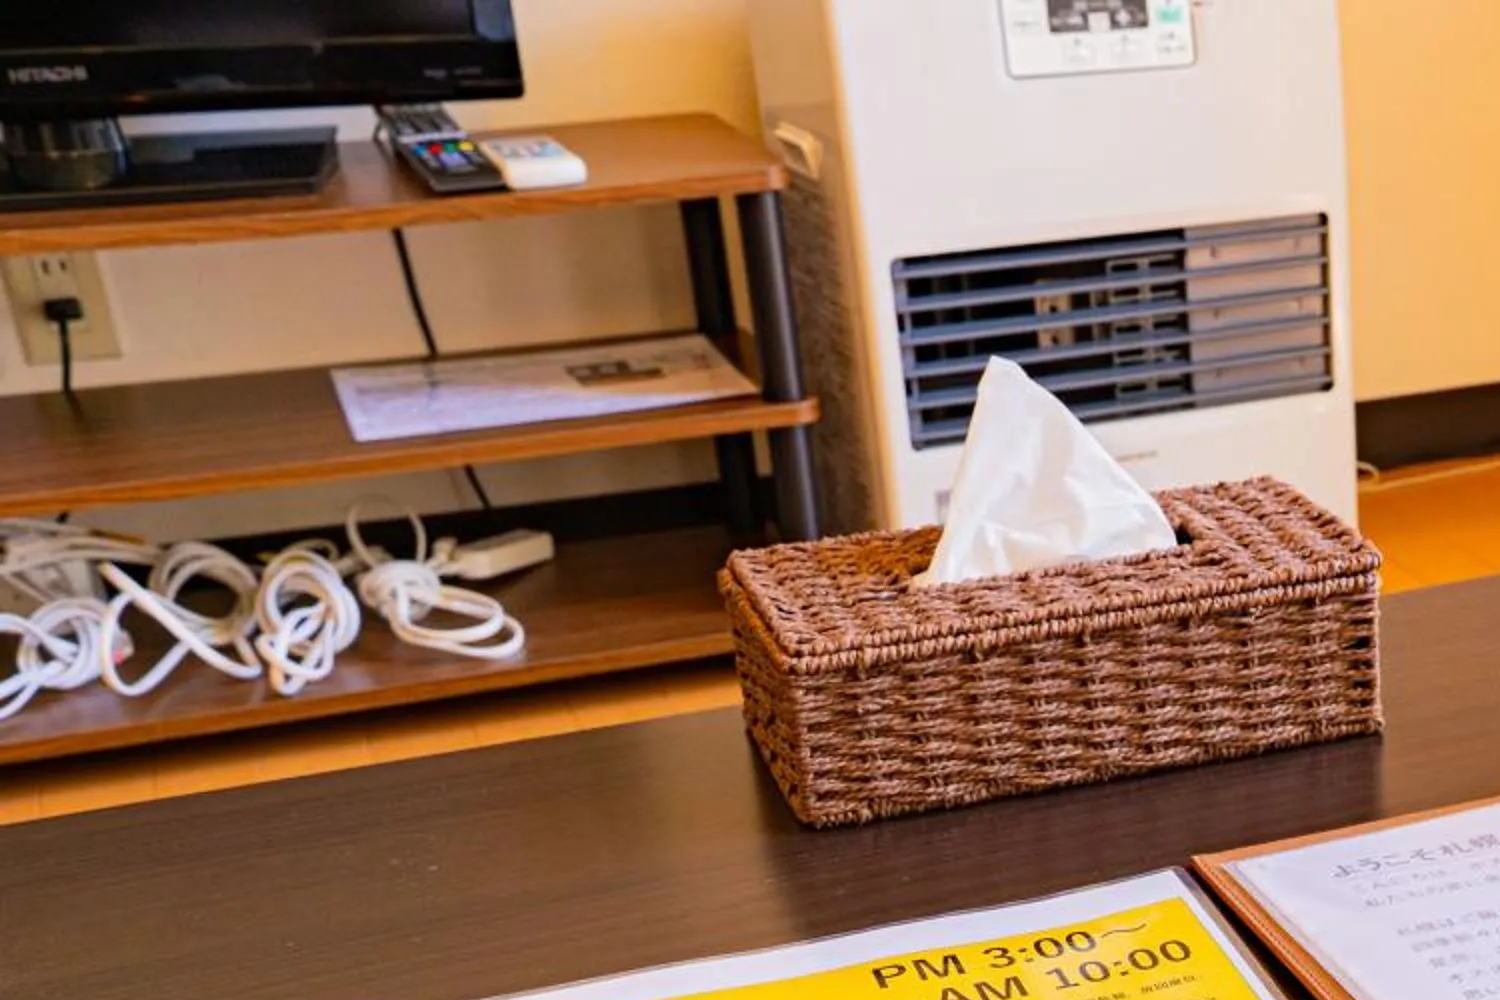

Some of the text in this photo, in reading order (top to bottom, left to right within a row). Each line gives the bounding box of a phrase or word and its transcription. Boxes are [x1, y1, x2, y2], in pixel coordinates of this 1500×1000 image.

[8, 64, 88, 84] HITACHI
[872, 953, 965, 990] PM
[1045, 939, 1192, 991] 10:00
